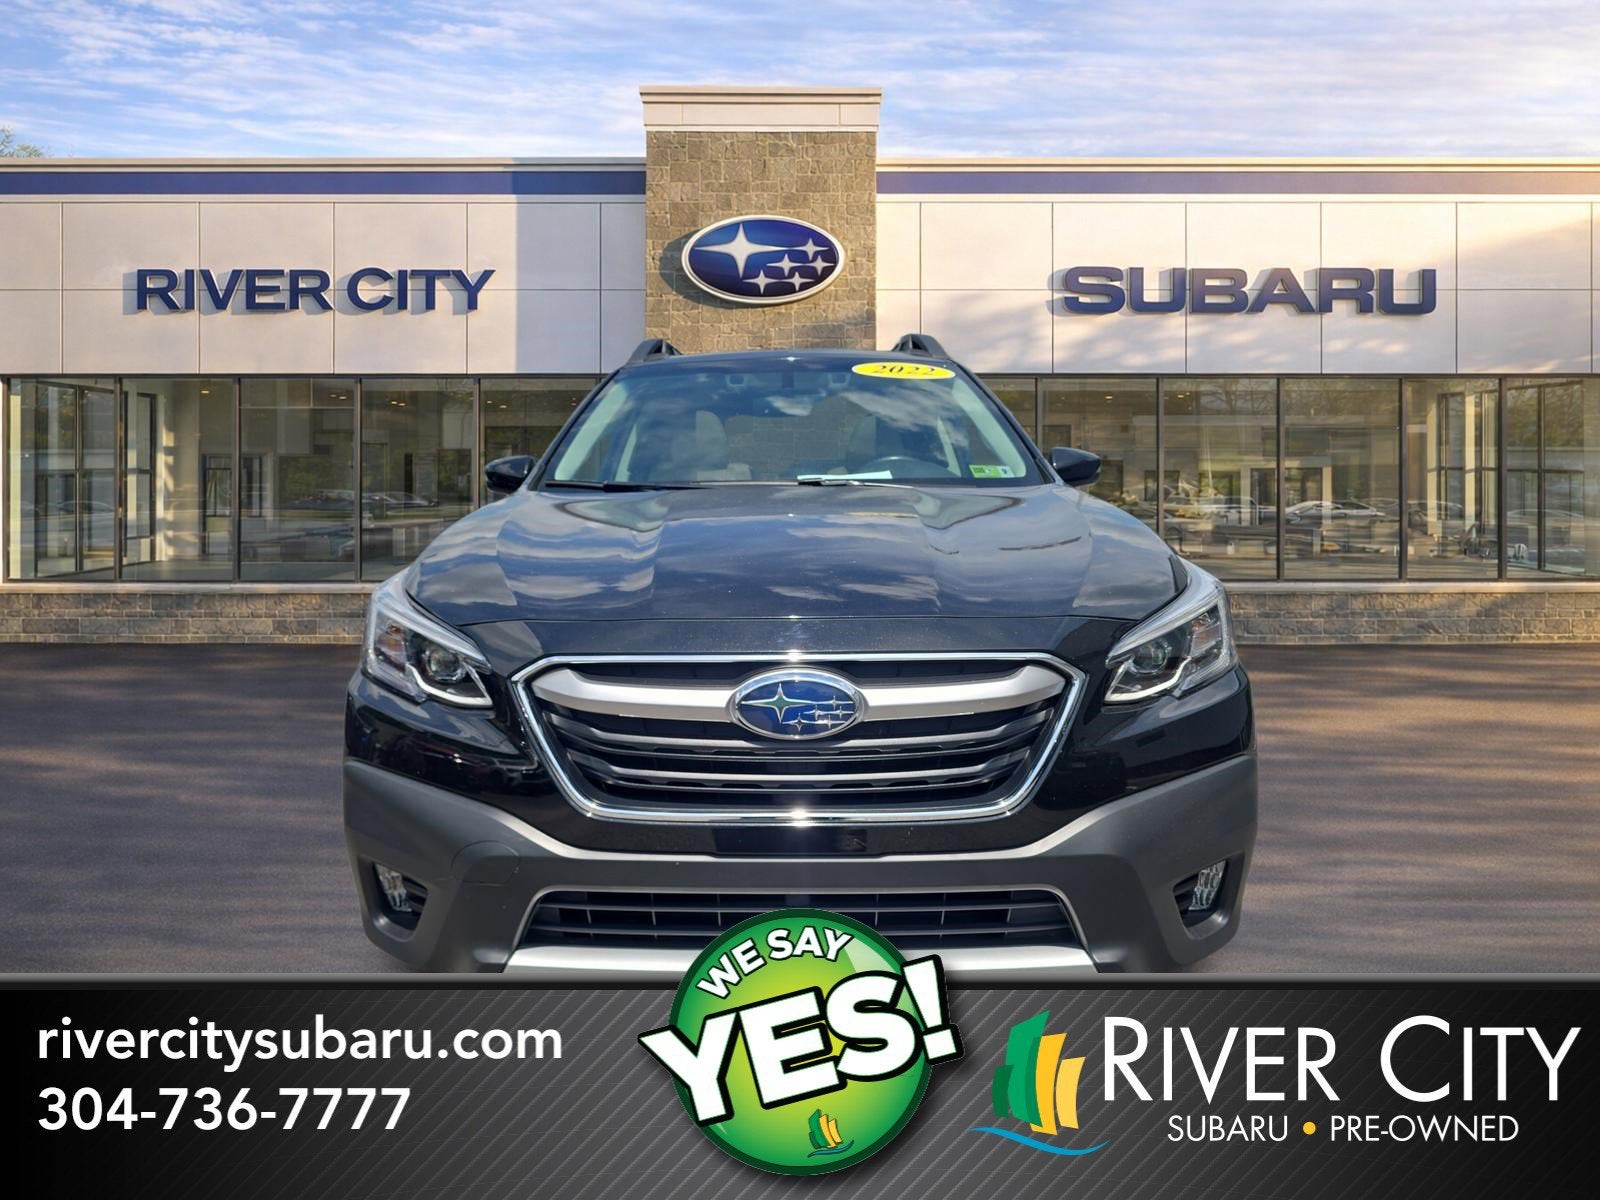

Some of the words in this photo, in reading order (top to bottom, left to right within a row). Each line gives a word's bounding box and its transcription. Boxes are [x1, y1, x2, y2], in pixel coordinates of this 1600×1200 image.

[136, 269, 332, 311] RIVER
[346, 267, 495, 311] CITY
[1062, 266, 1437, 315] SUBARU
[871, 364, 937, 376] 2022
